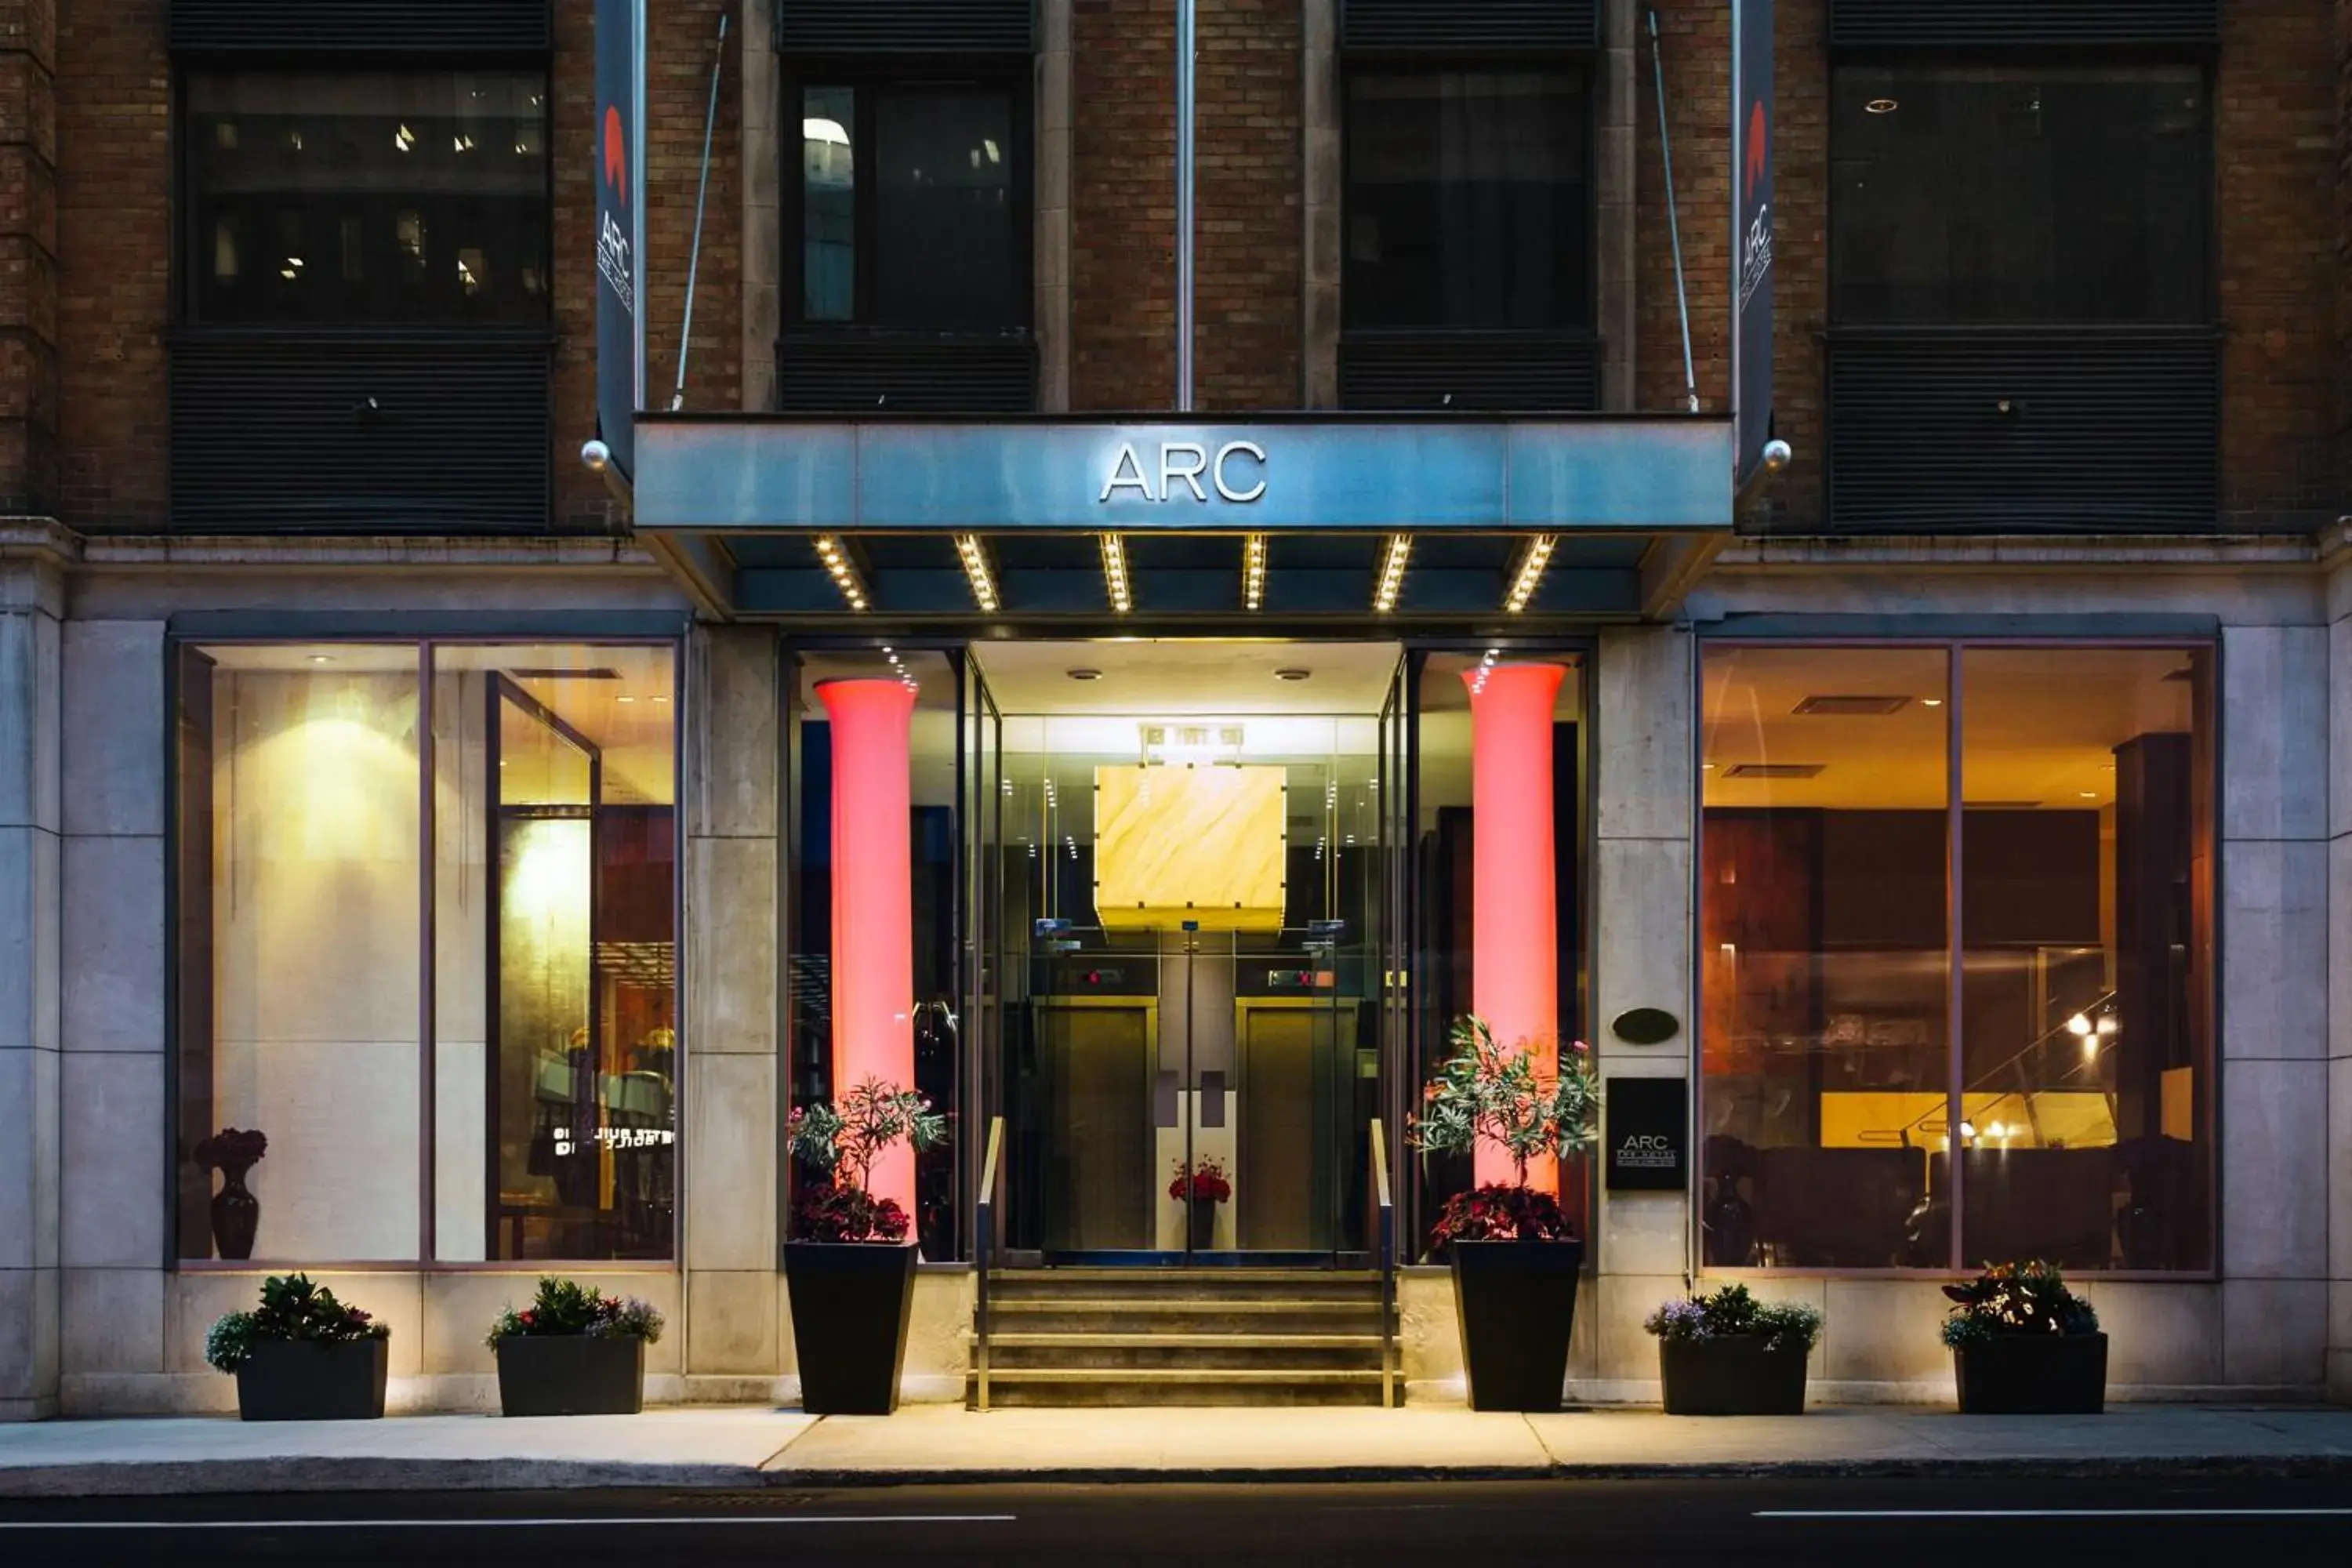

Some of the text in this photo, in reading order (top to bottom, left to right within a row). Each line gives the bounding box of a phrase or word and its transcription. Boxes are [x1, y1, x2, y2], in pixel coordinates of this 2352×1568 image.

[601, 210, 630, 278] ARC
[1743, 203, 1767, 278] ARC
[1099, 441, 1266, 503] ARC
[1624, 1135, 1668, 1150] ARC
